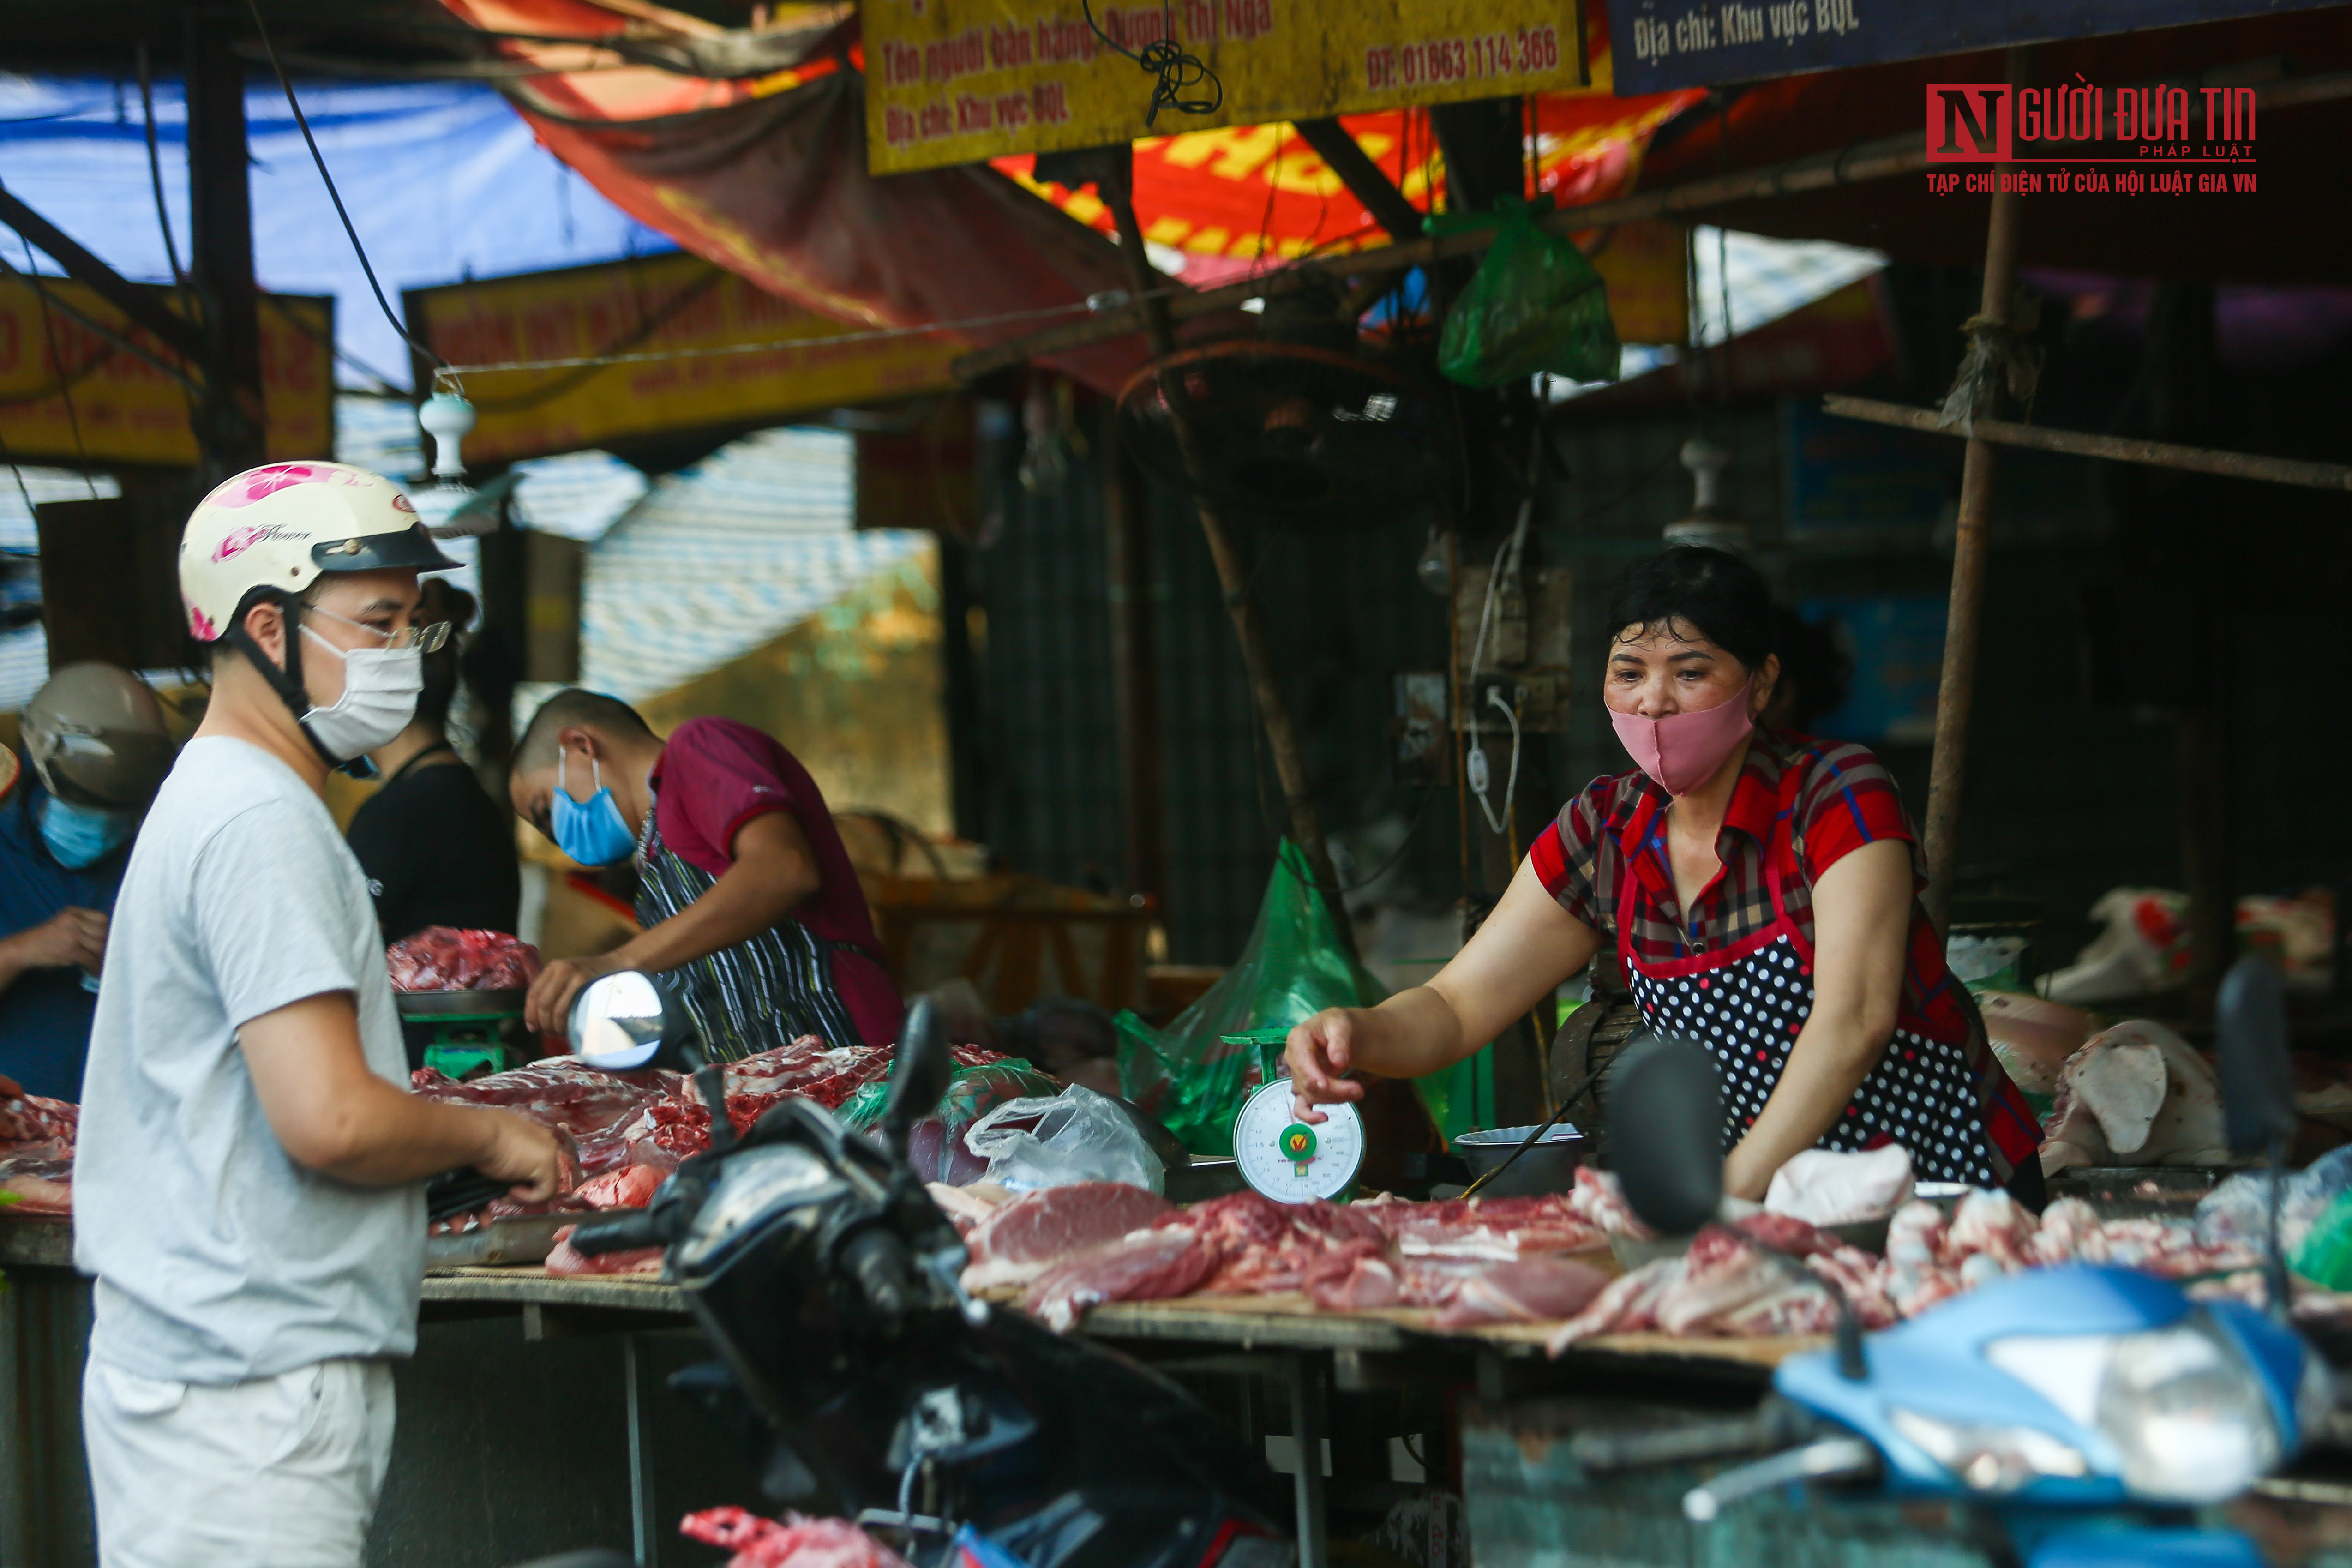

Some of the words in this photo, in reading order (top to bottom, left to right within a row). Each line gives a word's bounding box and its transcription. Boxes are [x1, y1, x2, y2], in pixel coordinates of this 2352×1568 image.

[1472, 35, 1512, 77] 114
[1517, 28, 1558, 72] 366
[1633, 16, 1670, 67] Địa
[1675, 4, 1716, 53] chỉ:
[1720, 2, 1764, 46] Khu
[1769, 0, 1809, 47] vực
[1815, 0, 1860, 37] BQL
[883, 40, 920, 84] Tên
[956, 93, 992, 131] Khu
[1032, 82, 1068, 125] BQL
